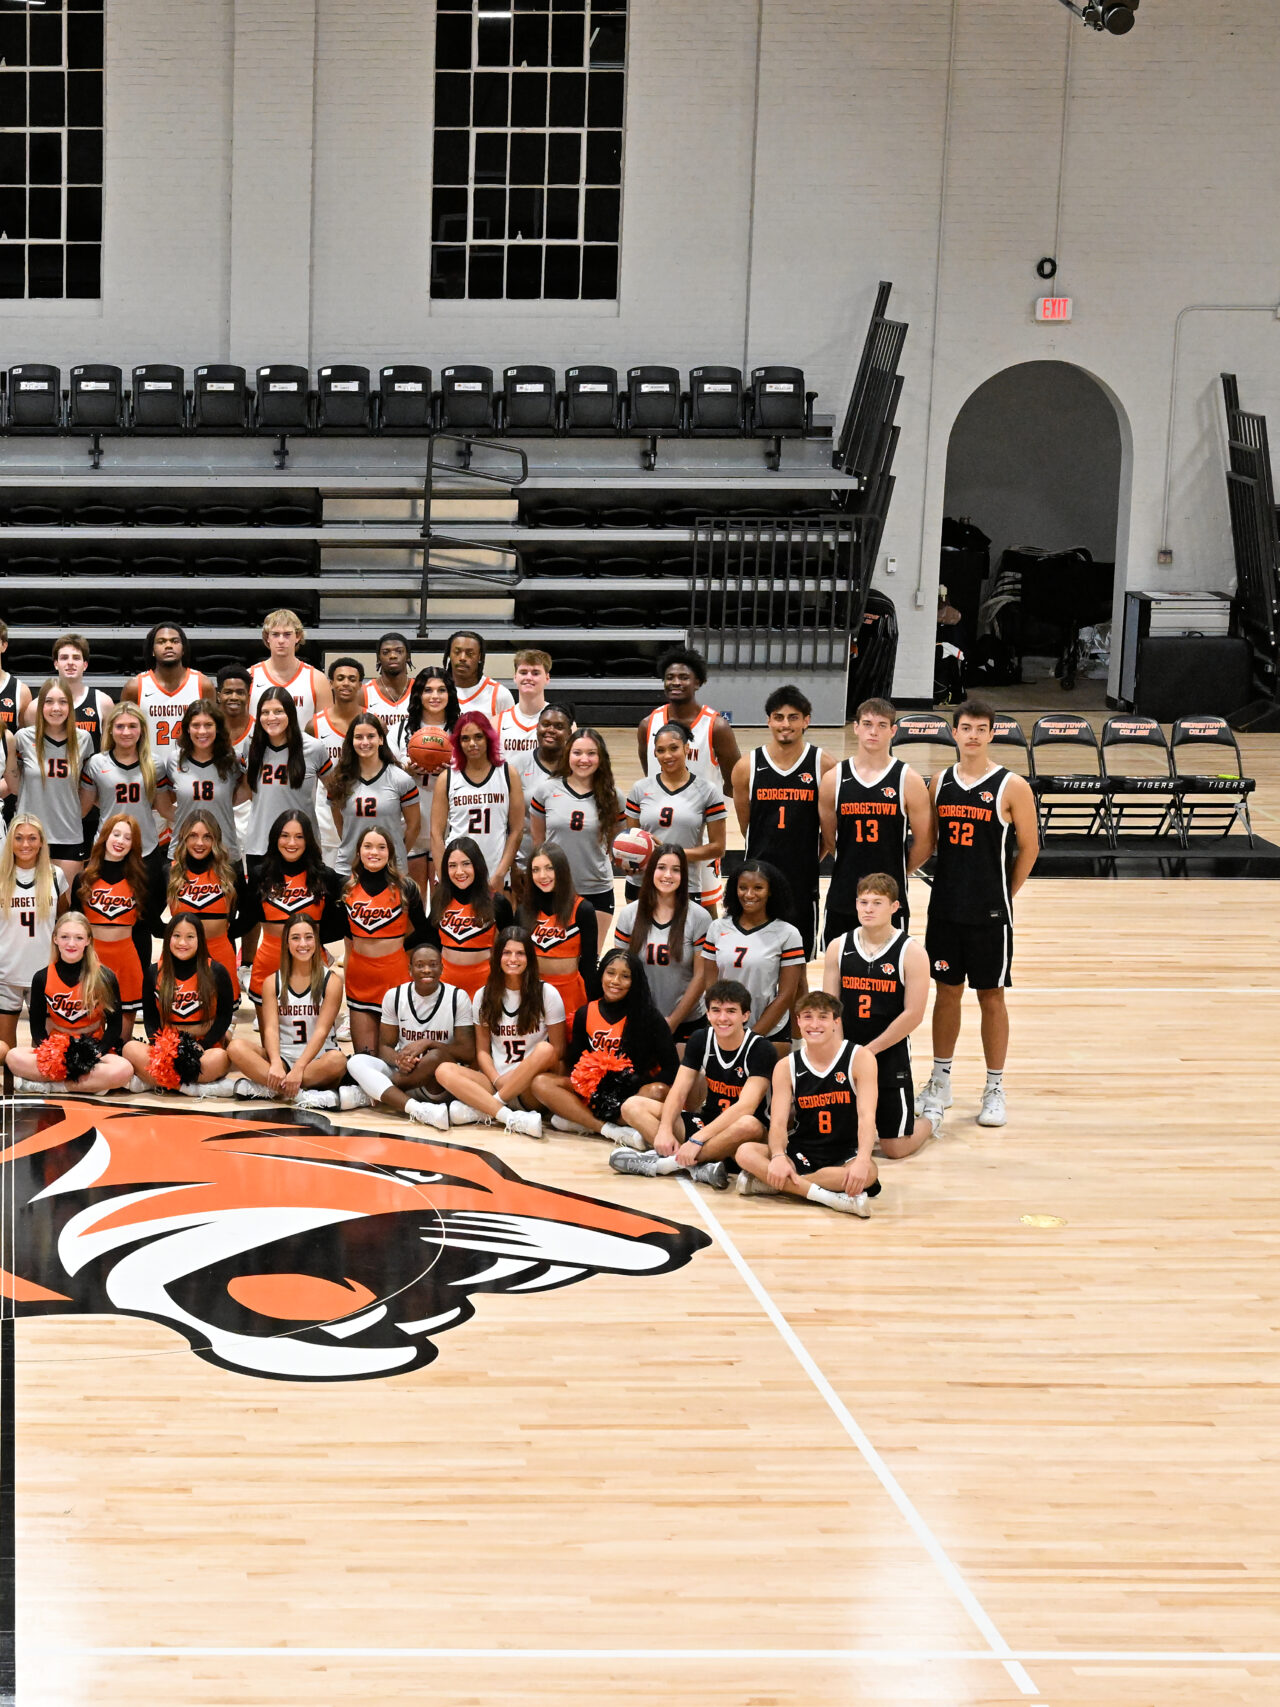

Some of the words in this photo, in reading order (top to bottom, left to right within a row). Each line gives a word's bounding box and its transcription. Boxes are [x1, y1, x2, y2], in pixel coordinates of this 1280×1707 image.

[1042, 299, 1068, 319] EXIT
[156, 721, 182, 745] 24
[504, 739, 538, 751] GEORGETO
[47, 758, 69, 778] 15
[262, 764, 288, 786] 24
[115, 783, 140, 804] 20
[192, 781, 214, 801] 18
[756, 788, 815, 802] GEORGETOWN
[1063, 781, 1101, 789] TIGERS
[1137, 781, 1174, 789] TIGERS
[1208, 781, 1245, 789] TIGERS
[355, 797, 377, 818] 12
[453, 793, 505, 807] GEORGETOWN
[840, 802, 897, 816] GEORGETOWN
[468, 808, 490, 834] 21
[570, 811, 584, 831] 8
[659, 807, 673, 828] 9
[777, 806, 786, 829] 1
[938, 805, 993, 822] GEORGETOWN
[854, 819, 879, 843] 13
[948, 821, 974, 846] 32
[176, 877, 222, 902] Tigers
[89, 888, 134, 913] Tigers
[350, 899, 393, 925] Tigers
[20, 911, 35, 937] 4
[646, 943, 670, 966] 16
[733, 946, 748, 968] 7
[842, 975, 897, 993] GEORGETOWN
[858, 995, 872, 1018] 2
[292, 1020, 307, 1044] 3
[592, 1028, 622, 1052] Tige
[503, 1039, 526, 1064] 15
[798, 1091, 851, 1109] GEORGETOWN
[818, 1110, 832, 1134] 8
